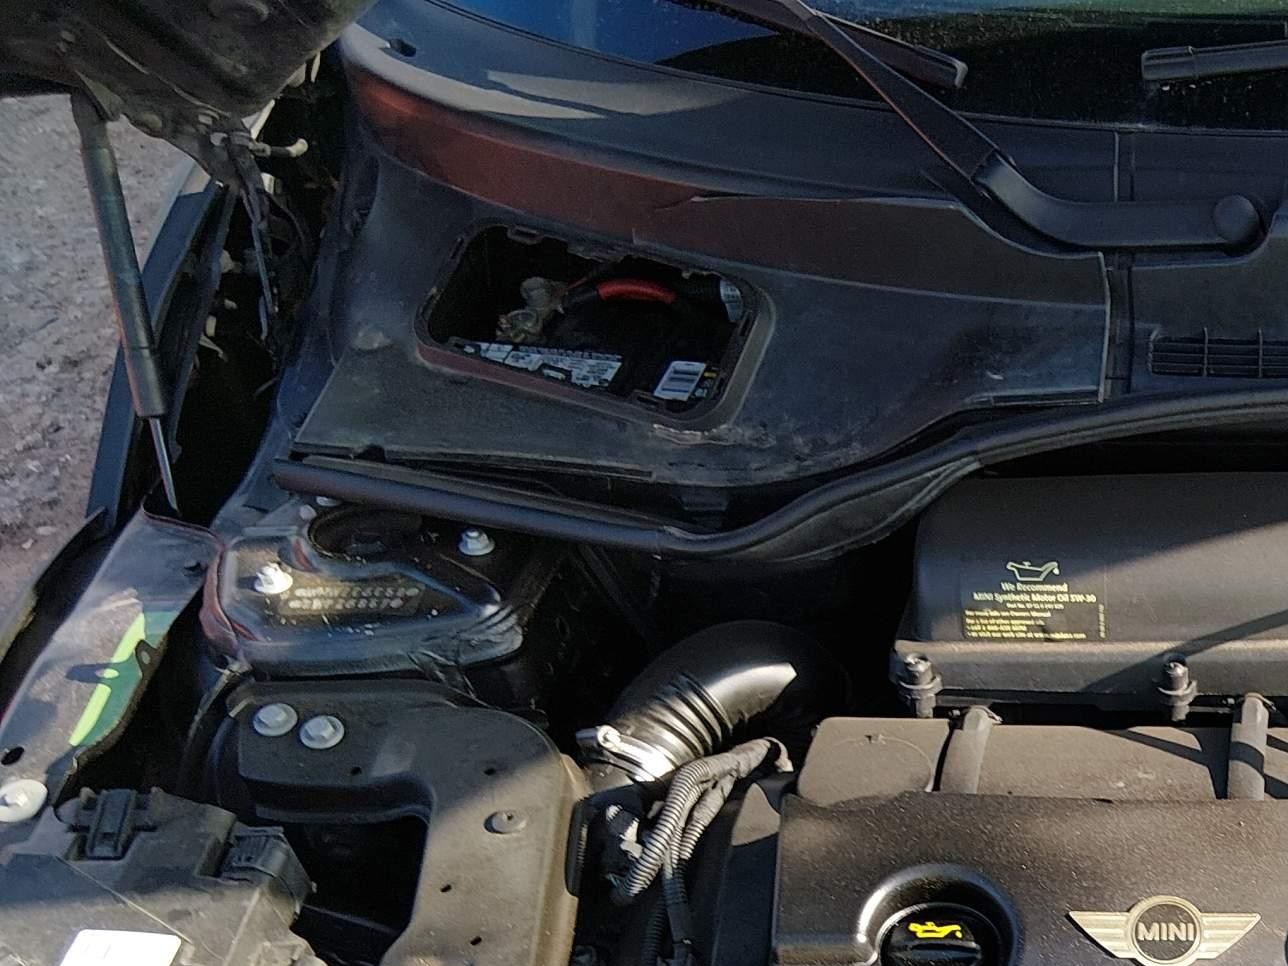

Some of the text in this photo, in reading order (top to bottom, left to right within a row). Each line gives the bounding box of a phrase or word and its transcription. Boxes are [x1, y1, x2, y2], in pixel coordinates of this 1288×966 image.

[1016, 582, 1068, 592] Recommend
[994, 592, 1031, 603] Synthetic
[1031, 593, 1056, 602] Motor
[1057, 593, 1069, 602] Oil
[1137, 922, 1195, 941] MINI
